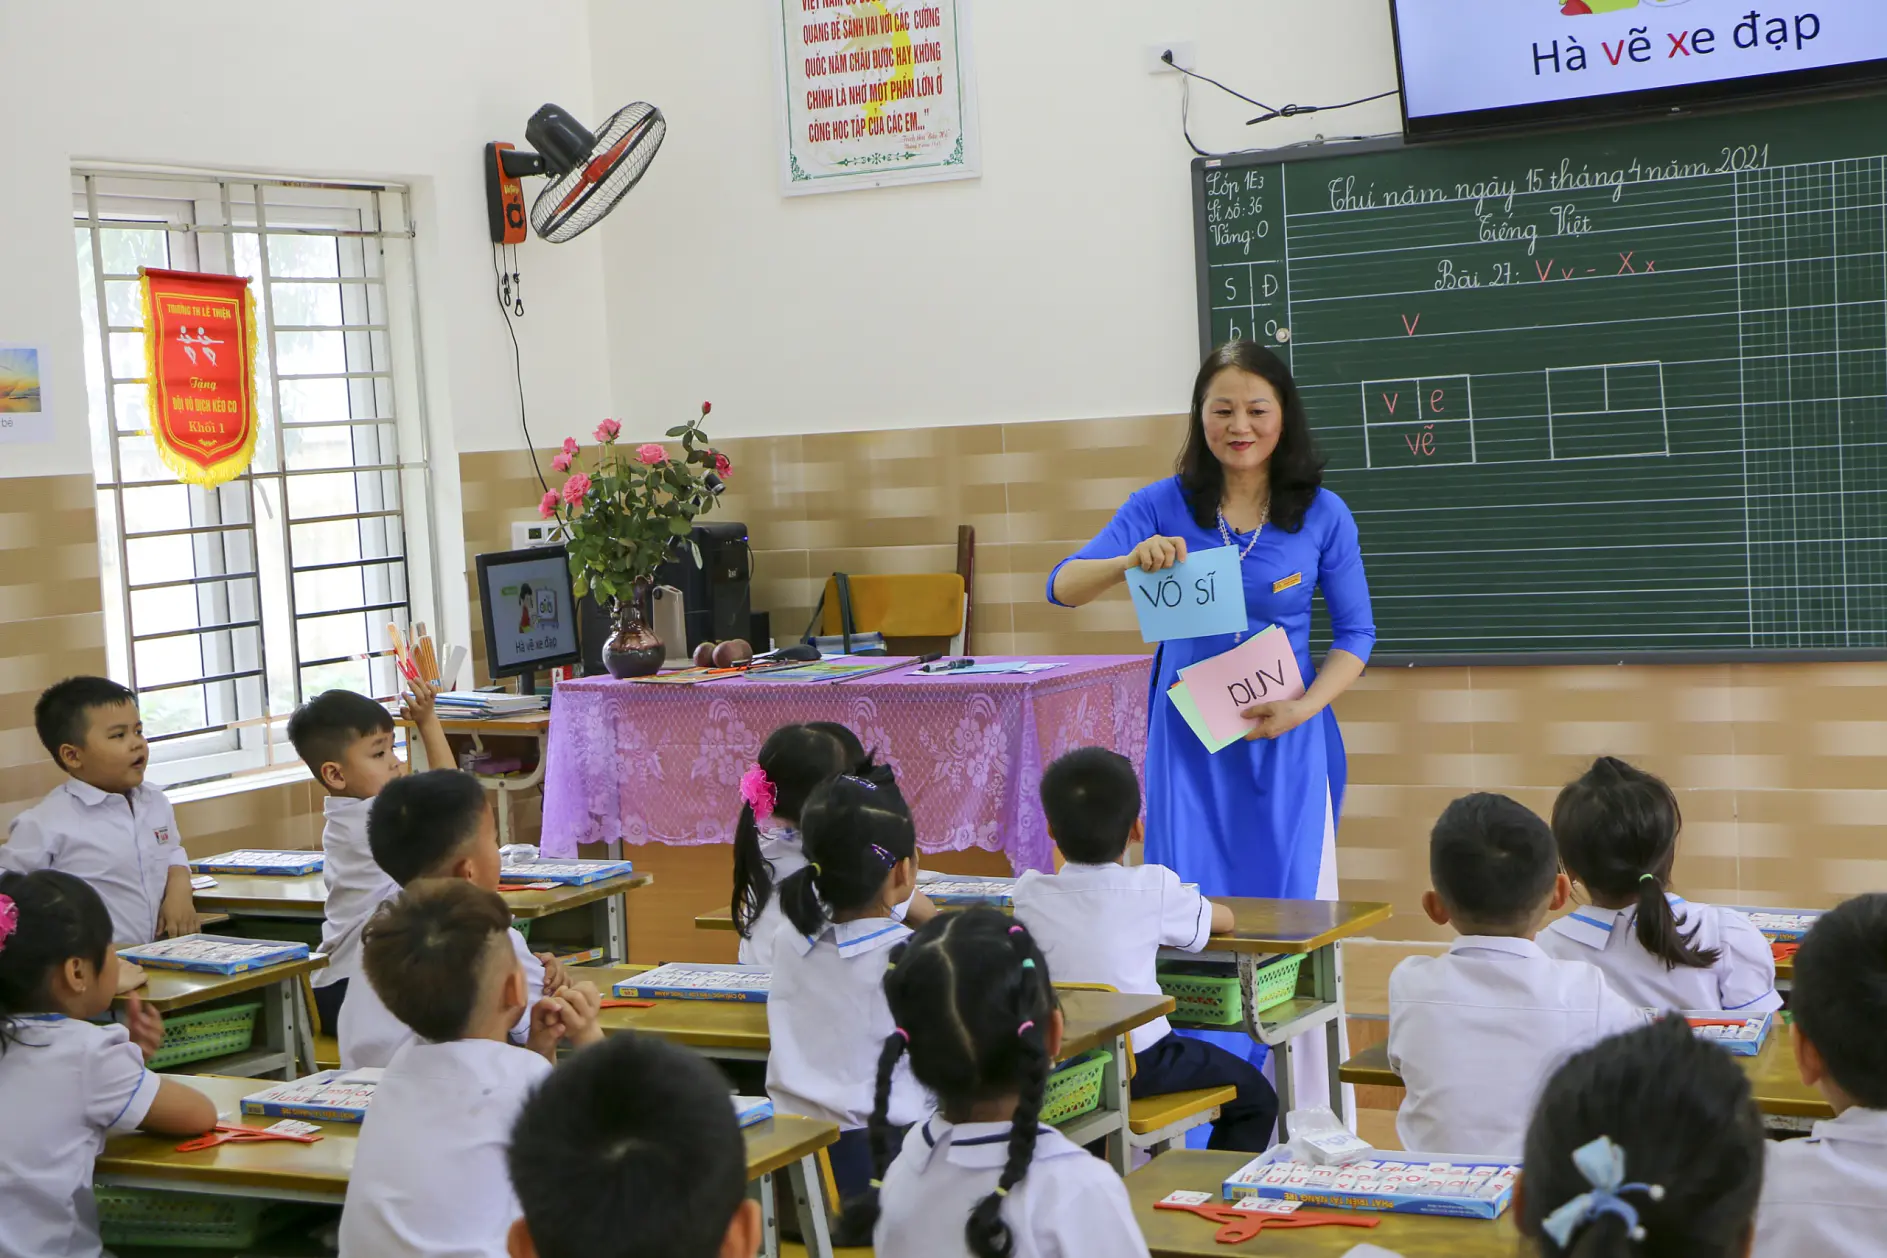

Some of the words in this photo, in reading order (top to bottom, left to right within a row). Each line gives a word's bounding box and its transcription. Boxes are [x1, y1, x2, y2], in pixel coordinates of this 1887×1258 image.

[803, 23, 829, 46] QUANG
[831, 12, 841, 41] ĐỂ
[842, 15, 864, 39] SÁNH
[866, 15, 878, 36] VAI
[880, 9, 893, 34] VỚI
[894, 8, 910, 32] CÁC
[1532, 35, 1588, 76] Hà
[1602, 26, 1651, 66] vẽ
[1667, 27, 1715, 59] xe
[1733, 10, 1821, 51] đạp
[805, 47, 827, 79] QUỐC
[828, 49, 848, 74] NĂM
[849, 47, 871, 72] CHÂU
[872, 46, 894, 73] ĐƯỢC
[896, 44, 913, 66] HAY
[913, 38, 941, 64] KHÔNG
[806, 84, 834, 111] CHÍNH
[836, 82, 847, 107] LÀ
[849, 78, 868, 105] NHỜ
[869, 78, 888, 106] MỘT
[890, 72, 915, 101] PHẦN
[917, 71, 934, 97] LỚN
[808, 118, 831, 143] CÔNG
[832, 118, 849, 144] HỌC
[850, 114, 866, 142] TẬP
[868, 107, 885, 136] CỦA
[886, 109, 903, 134] CÁC
[1205, 171, 1240, 201] Lớp
[1328, 174, 1377, 211] Thứ
[1382, 184, 1448, 208] năm
[1454, 175, 1517, 217] ngày
[1525, 168, 1545, 193] 15
[1549, 157, 1625, 203] tháng
[1627, 157, 1642, 182] 4
[1644, 160, 1711, 182] năm
[1714, 143, 1769, 174] 2021
[1247, 196, 1263, 216] 36
[1478, 212, 1538, 256] Tiếng
[1549, 203, 1593, 239] Việt
[1224, 276, 1238, 301] S
[1261, 273, 1280, 298] Đ
[1434, 259, 1481, 291] Bài
[189, 375, 218, 392] Tặng
[1428, 388, 1446, 414] e
[1404, 422, 1437, 457] vẽ
